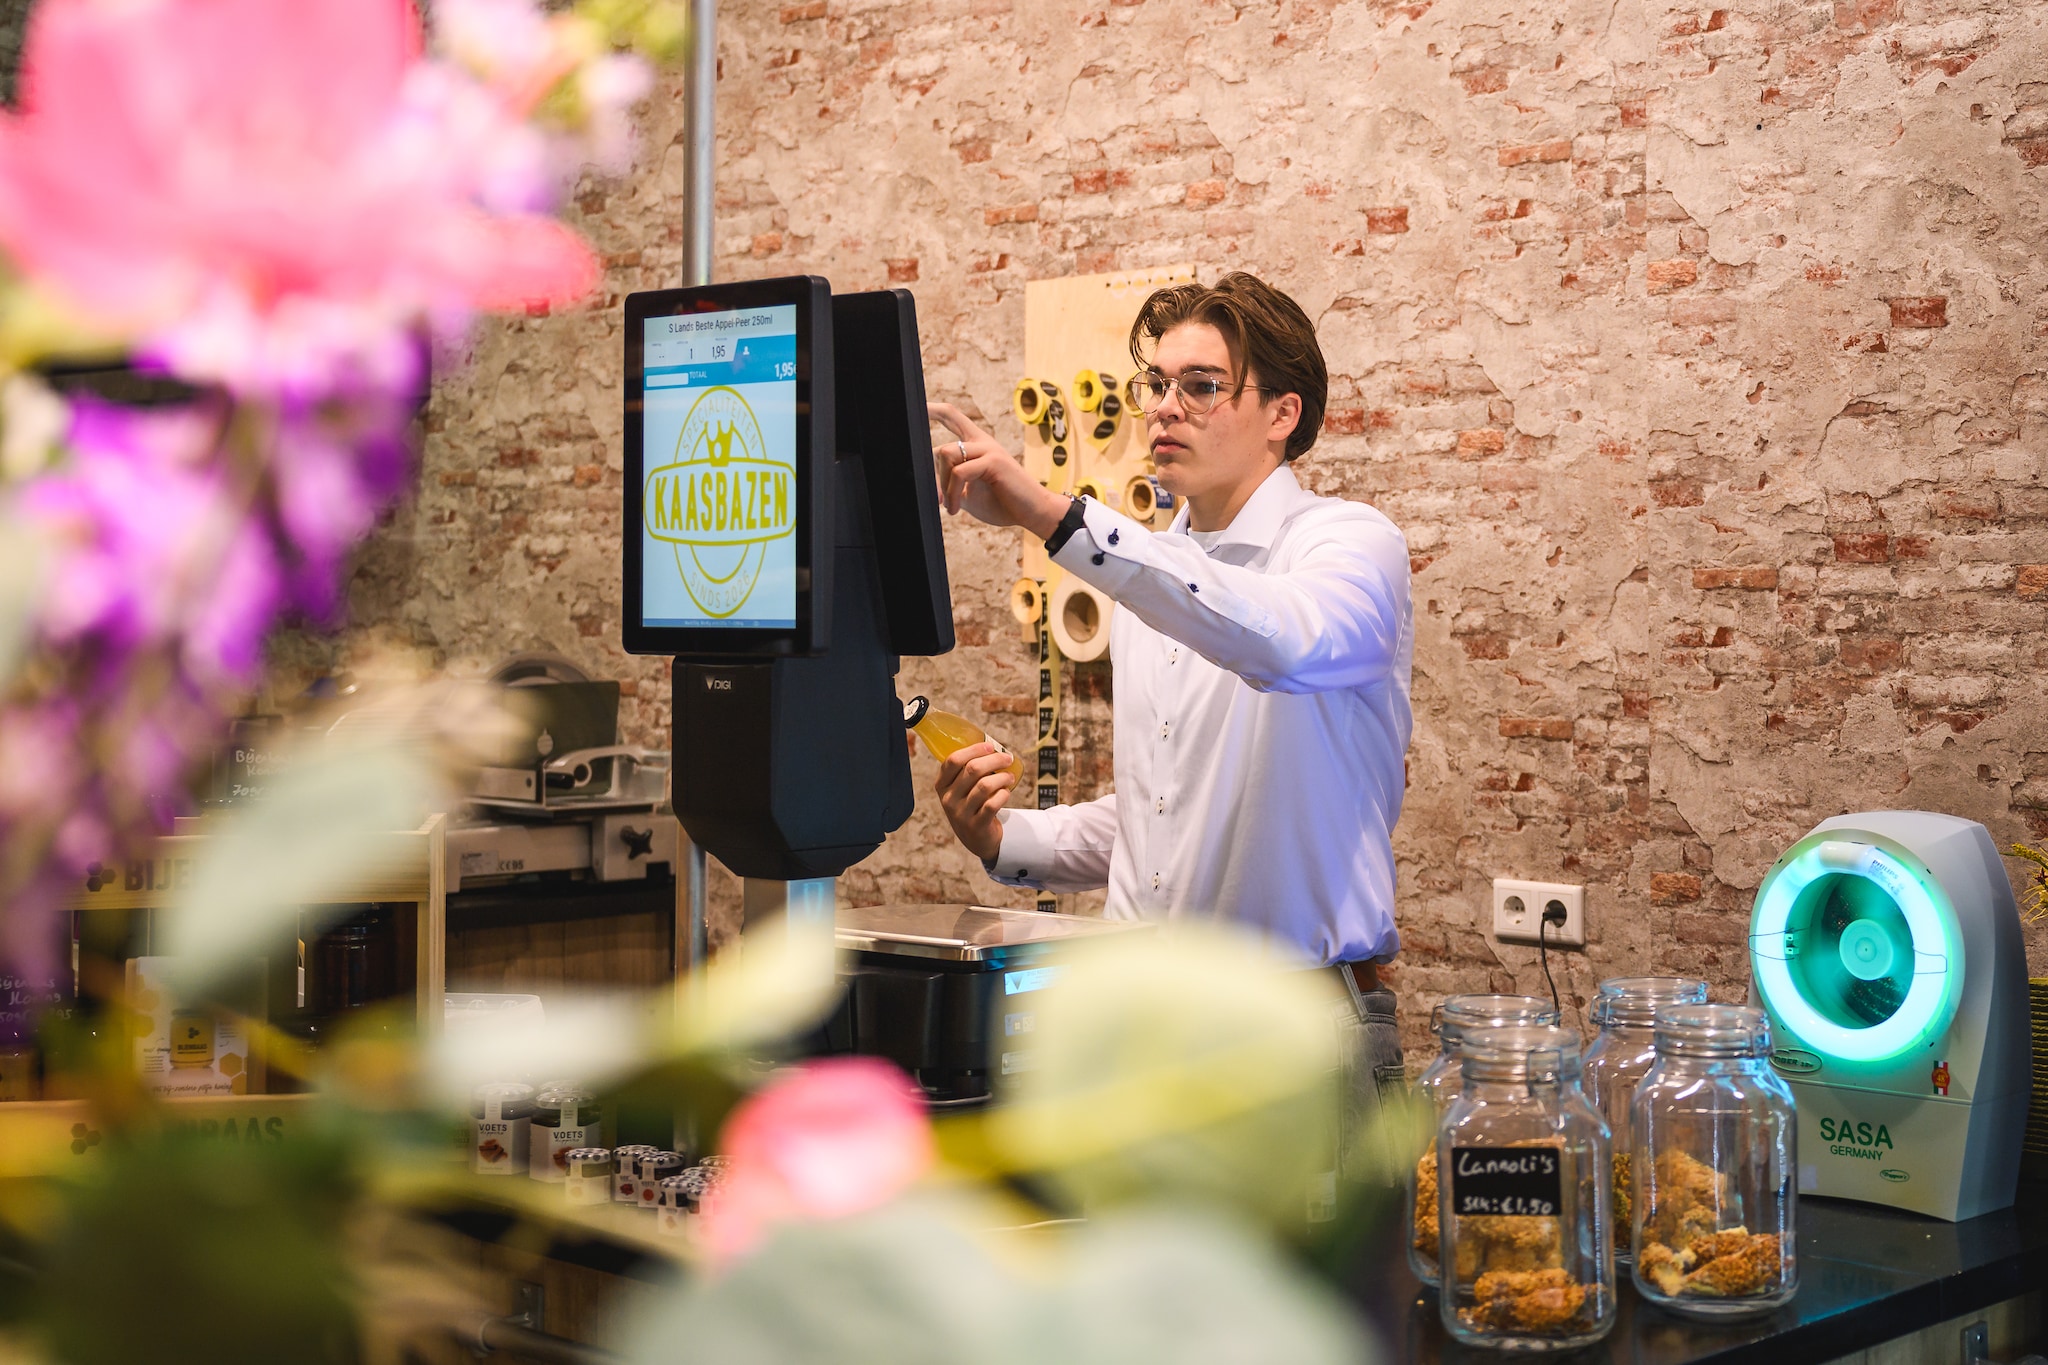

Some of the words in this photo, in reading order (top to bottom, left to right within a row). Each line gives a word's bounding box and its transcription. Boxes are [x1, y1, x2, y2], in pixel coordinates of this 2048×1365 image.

[675, 321, 694, 332] Lands
[695, 319, 713, 331] Beste
[752, 314, 773, 326] 250ml
[712, 345, 725, 359] 1,95
[654, 471, 788, 532] KAASBAZEN
[691, 571, 721, 609] SINDS
[714, 680, 732, 690] DIGI
[1872, 859, 1899, 879] PHILIPS
[479, 1123, 507, 1132] VOETS
[553, 1131, 583, 1139] VOETS
[1820, 1117, 1894, 1150] SASA
[1830, 1144, 1883, 1161] GERMANY
[1458, 1152, 1554, 1177] Cannoli's
